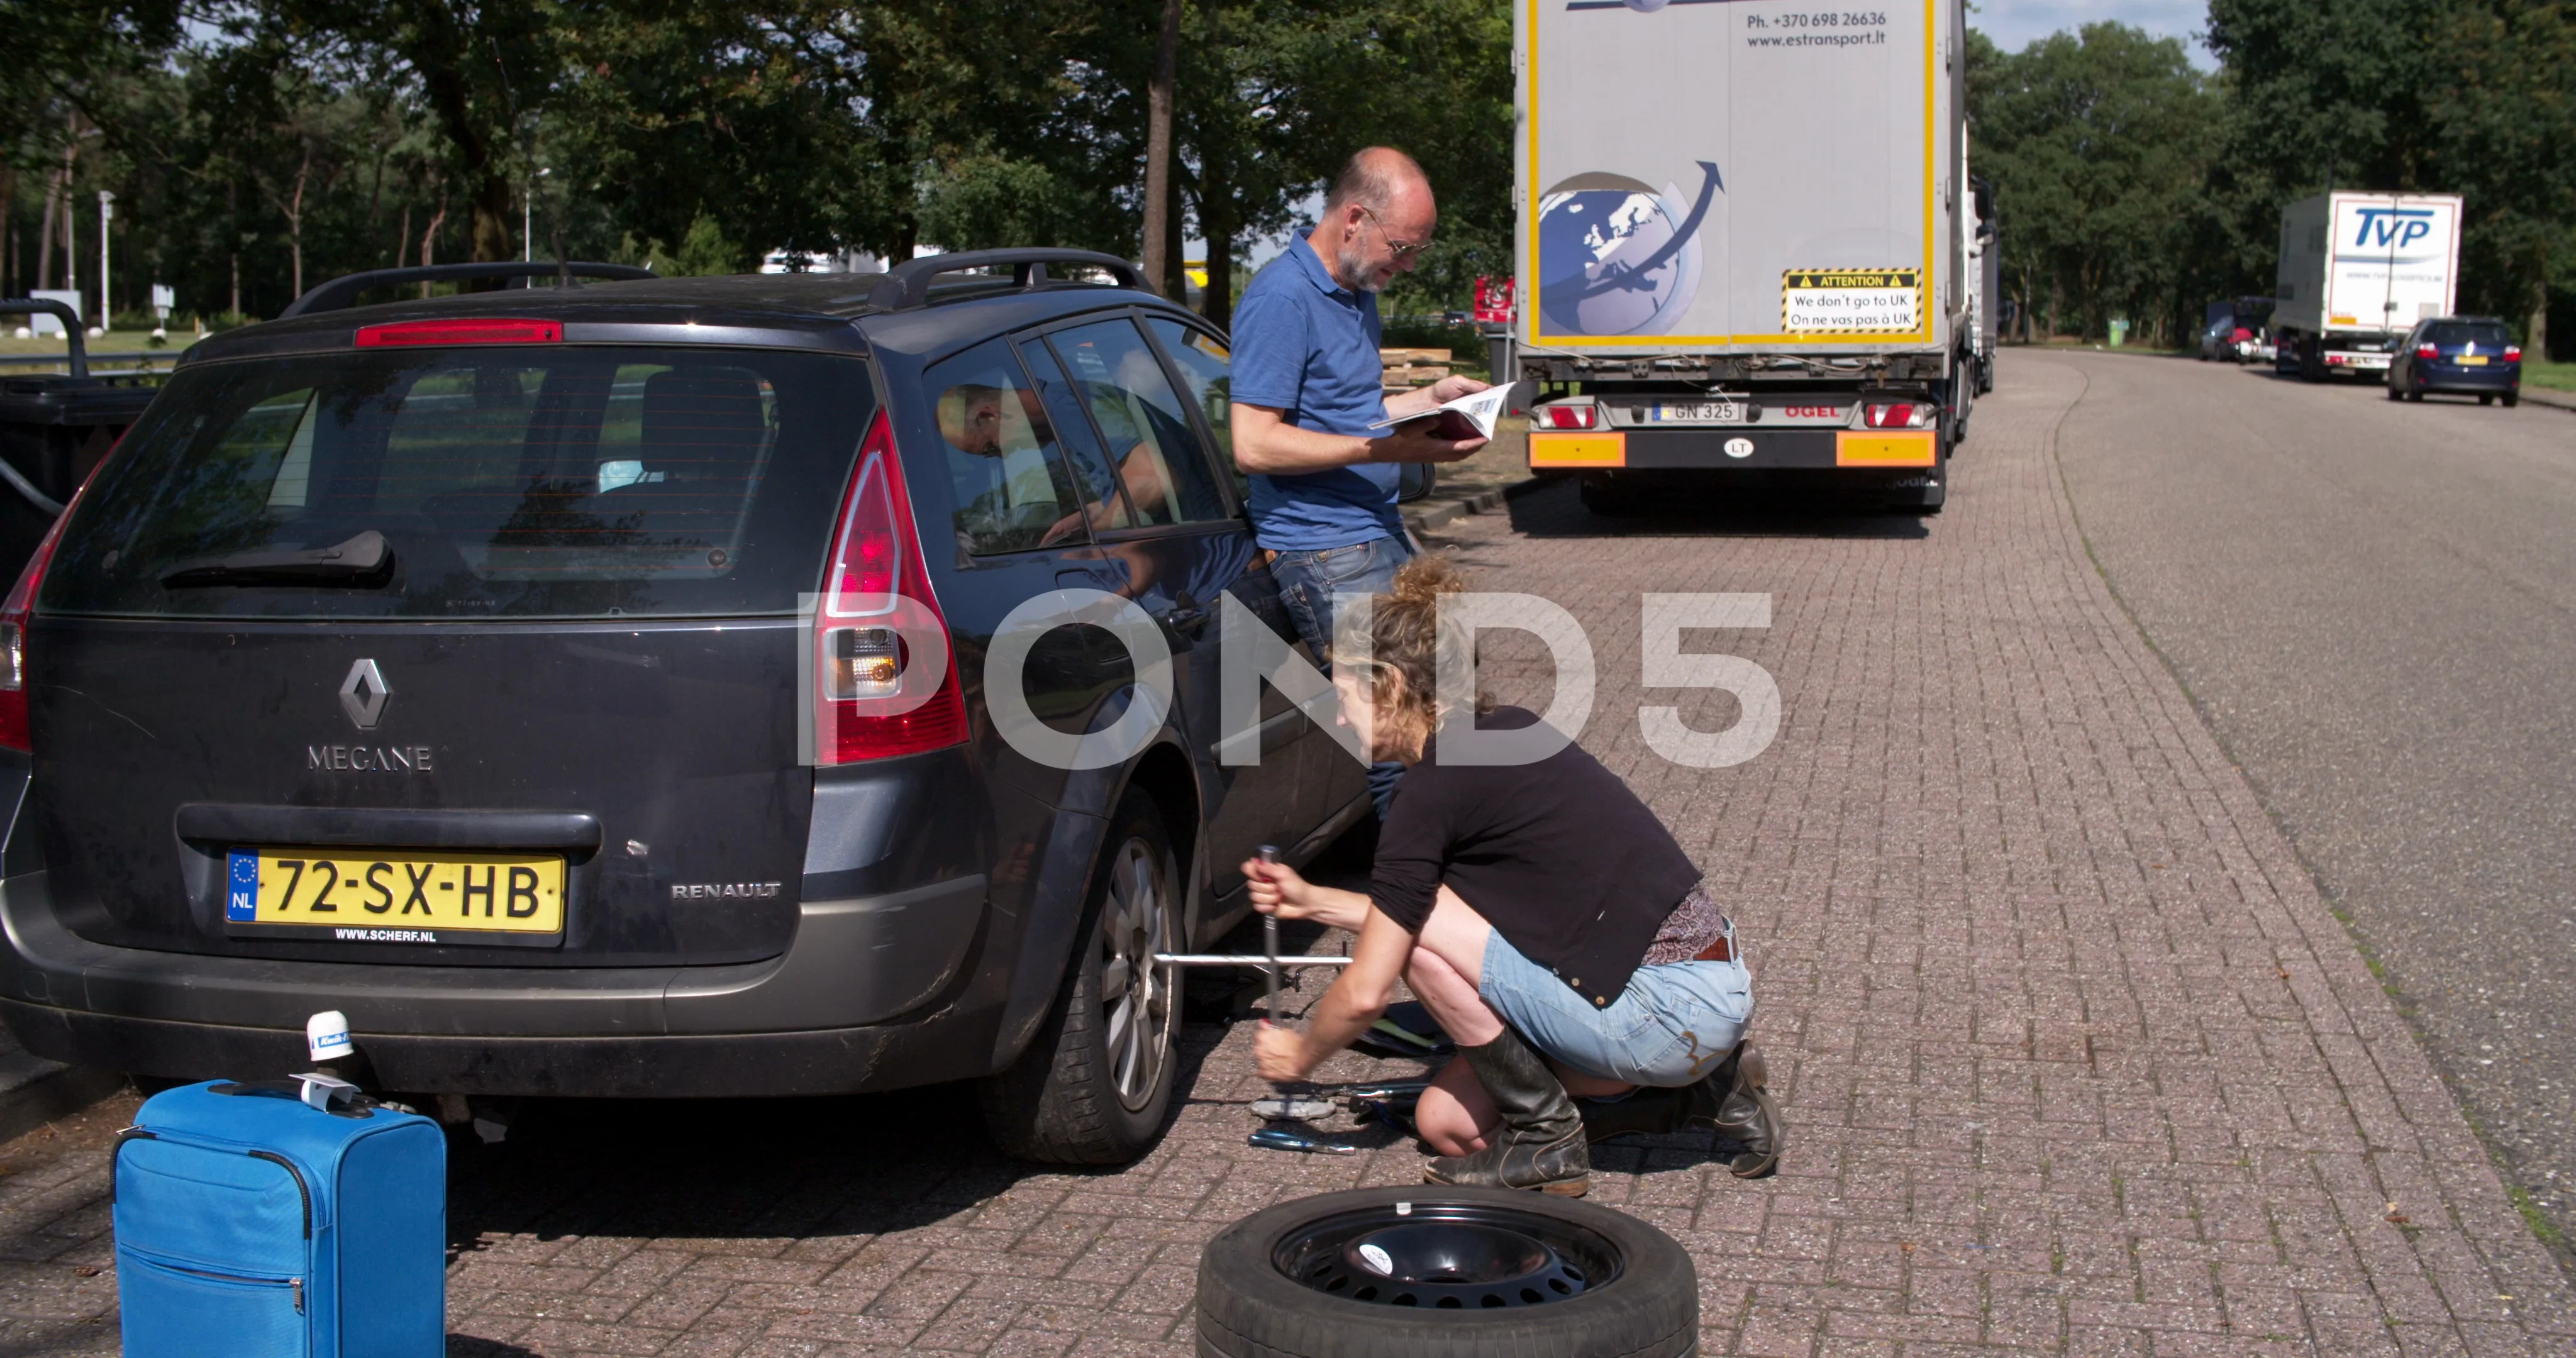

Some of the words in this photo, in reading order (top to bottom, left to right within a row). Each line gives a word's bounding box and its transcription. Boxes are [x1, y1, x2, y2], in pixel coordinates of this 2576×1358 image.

[1748, 14, 1768, 28] Ph.
[1774, 14, 1807, 28] +370
[1812, 13, 1838, 27] 698
[1842, 12, 1886, 26] 26636
[1748, 30, 1885, 48] www.estransport.lt
[2356, 208, 2434, 248] TVP
[1821, 276, 1884, 287] ATTENTION
[1795, 296, 1814, 307] We
[1818, 294, 1850, 306] don't
[1854, 298, 1870, 309] go
[1874, 295, 1887, 306] to
[1890, 295, 1907, 306] UK
[1791, 314, 1808, 325] On
[1813, 316, 1827, 324] ne
[1831, 316, 1852, 324] vas
[1856, 316, 1878, 327] pas
[1882, 313, 1889, 324] à
[1894, 313, 1911, 324] UK
[1675, 404, 1697, 418] GN
[1704, 403, 1733, 418] 325
[1731, 443, 1747, 453] LT
[308, 746, 432, 773] MEGANE
[277, 860, 539, 919] 72-SX-HB
[671, 883, 781, 900] RENAULT
[233, 893, 253, 908] NL
[335, 928, 436, 942] WWW.SCHERF.NL
